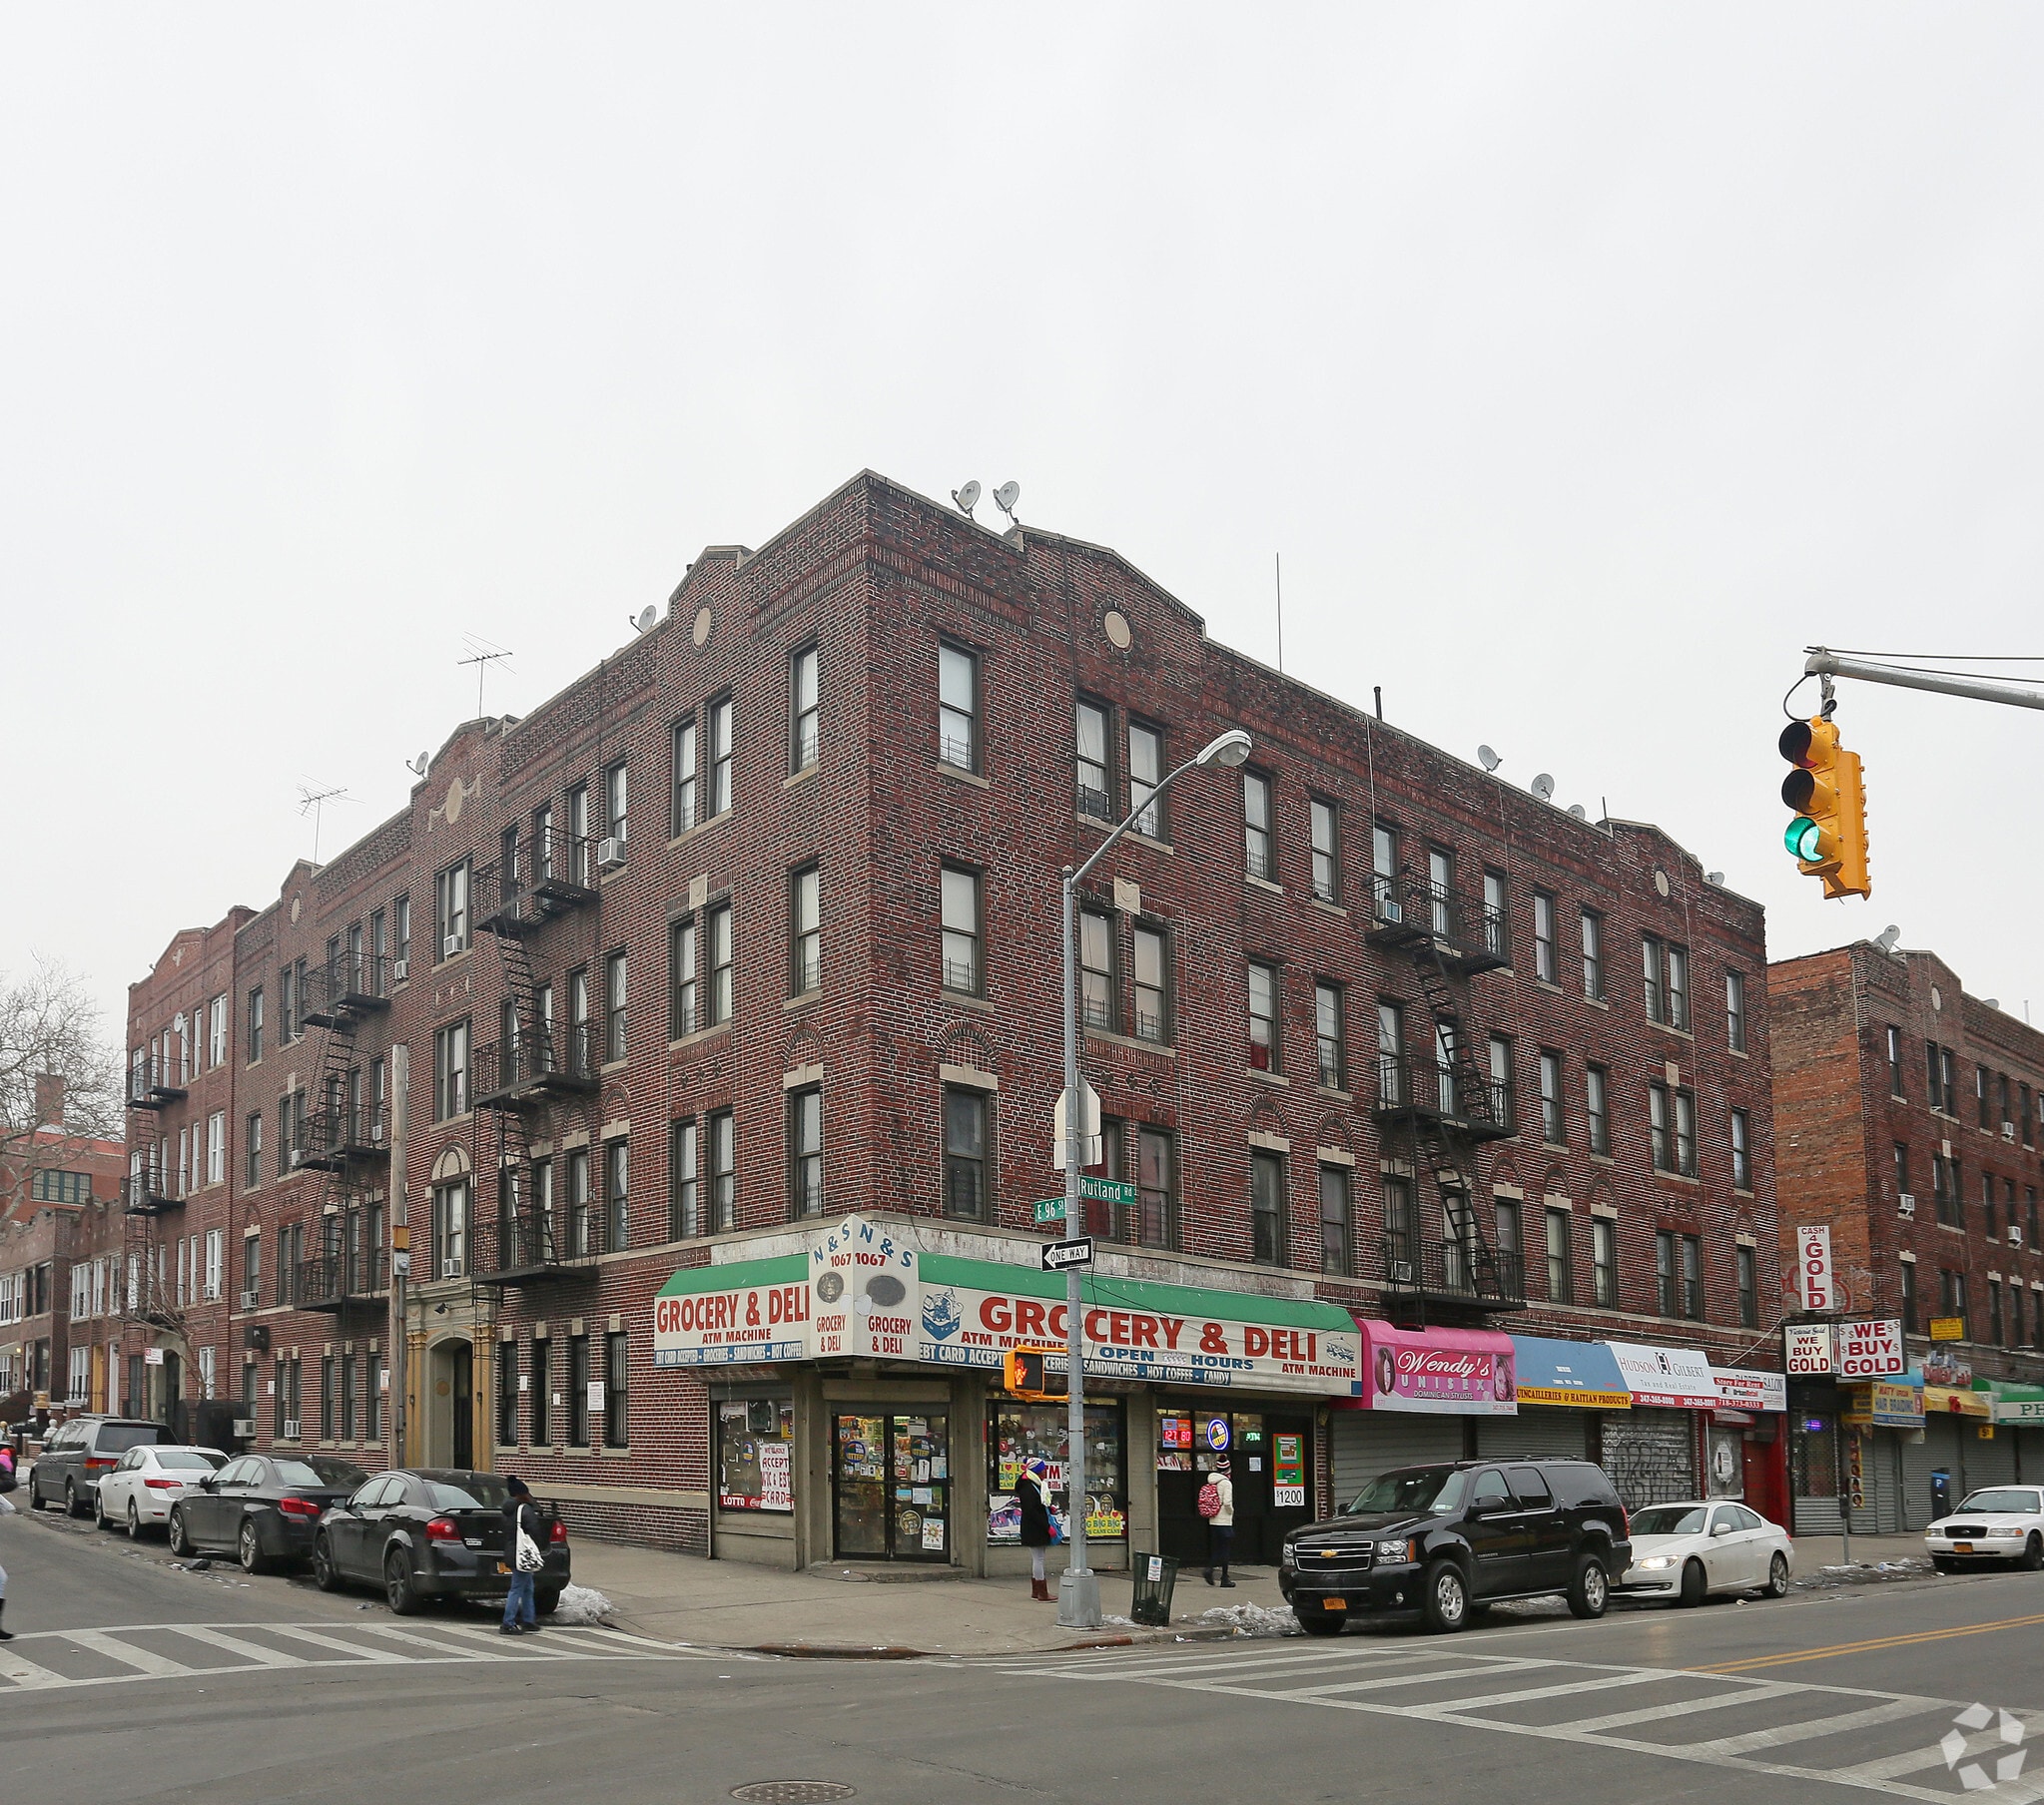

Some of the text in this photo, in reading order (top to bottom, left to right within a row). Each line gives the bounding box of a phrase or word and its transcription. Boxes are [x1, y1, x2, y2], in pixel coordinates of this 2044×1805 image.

[1080, 1179, 1132, 1200] Rutland Rd
[1037, 1204, 1041, 1219] E
[1044, 1202, 1055, 1218] 96
[813, 1223, 851, 1264] N & S
[859, 1224, 913, 1268] N & S
[831, 1253, 852, 1267] 1067
[855, 1252, 886, 1267] 1067
[1050, 1246, 1085, 1262] ONE WAY
[1805, 1242, 1826, 1309] GOLD
[657, 1285, 810, 1334] GROCERY & DELI
[817, 1315, 847, 1333] GROCERY
[868, 1315, 912, 1335] GROCERY
[980, 1296, 1316, 1363] GROCERY & DELI
[1853, 1322, 1887, 1339] WE
[702, 1328, 772, 1345] ATM MACHINE
[820, 1335, 841, 1353] & DELI
[961, 1331, 993, 1346] ATM
[1797, 1336, 1818, 1345] WE
[784, 1342, 803, 1358] COFFEE
[872, 1336, 903, 1354] & DELI
[1792, 1347, 1823, 1357] BUY
[1848, 1339, 1893, 1357] BUY
[939, 1346, 966, 1363] CARD
[969, 1349, 1005, 1366] ACCEPT
[1083, 1360, 1138, 1377] SANDWICHES
[1147, 1365, 1163, 1379] HOT
[1165, 1366, 1193, 1382] COFFEE
[1203, 1370, 1230, 1385] CANDY
[1099, 1346, 1254, 1371] OPEN HOURS
[1397, 1351, 1490, 1378] Wendy's
[1619, 1358, 1657, 1374] HUDSON
[1788, 1358, 1829, 1372] GOLD
[1843, 1358, 1901, 1375] GOLD
[1282, 1363, 1356, 1378] ATM MACHINE
[1674, 1363, 1704, 1378] GILBERT
[1401, 1374, 1485, 1391] UNISEX
[1640, 1379, 1651, 1388] Tax
[1679, 1383, 1697, 1392] Estate
[1763, 1378, 1783, 1392] SALON
[1414, 1390, 1450, 1399] DOMINICAN
[1517, 1388, 1562, 1401] UINCAILLERIES
[1571, 1393, 1598, 1404] HAITIAN
[1598, 1394, 1629, 1406] PRODUCTS
[1165, 1431, 1176, 1442] 127
[1180, 1431, 1191, 1442] 80
[762, 1457, 789, 1469] ACCEPT
[1045, 1465, 1060, 1480] TM
[1936, 1479, 1942, 1488] P
[723, 1496, 745, 1506] LOTTO
[766, 1491, 786, 1504] CARD
[1276, 1490, 1302, 1504] $1200
